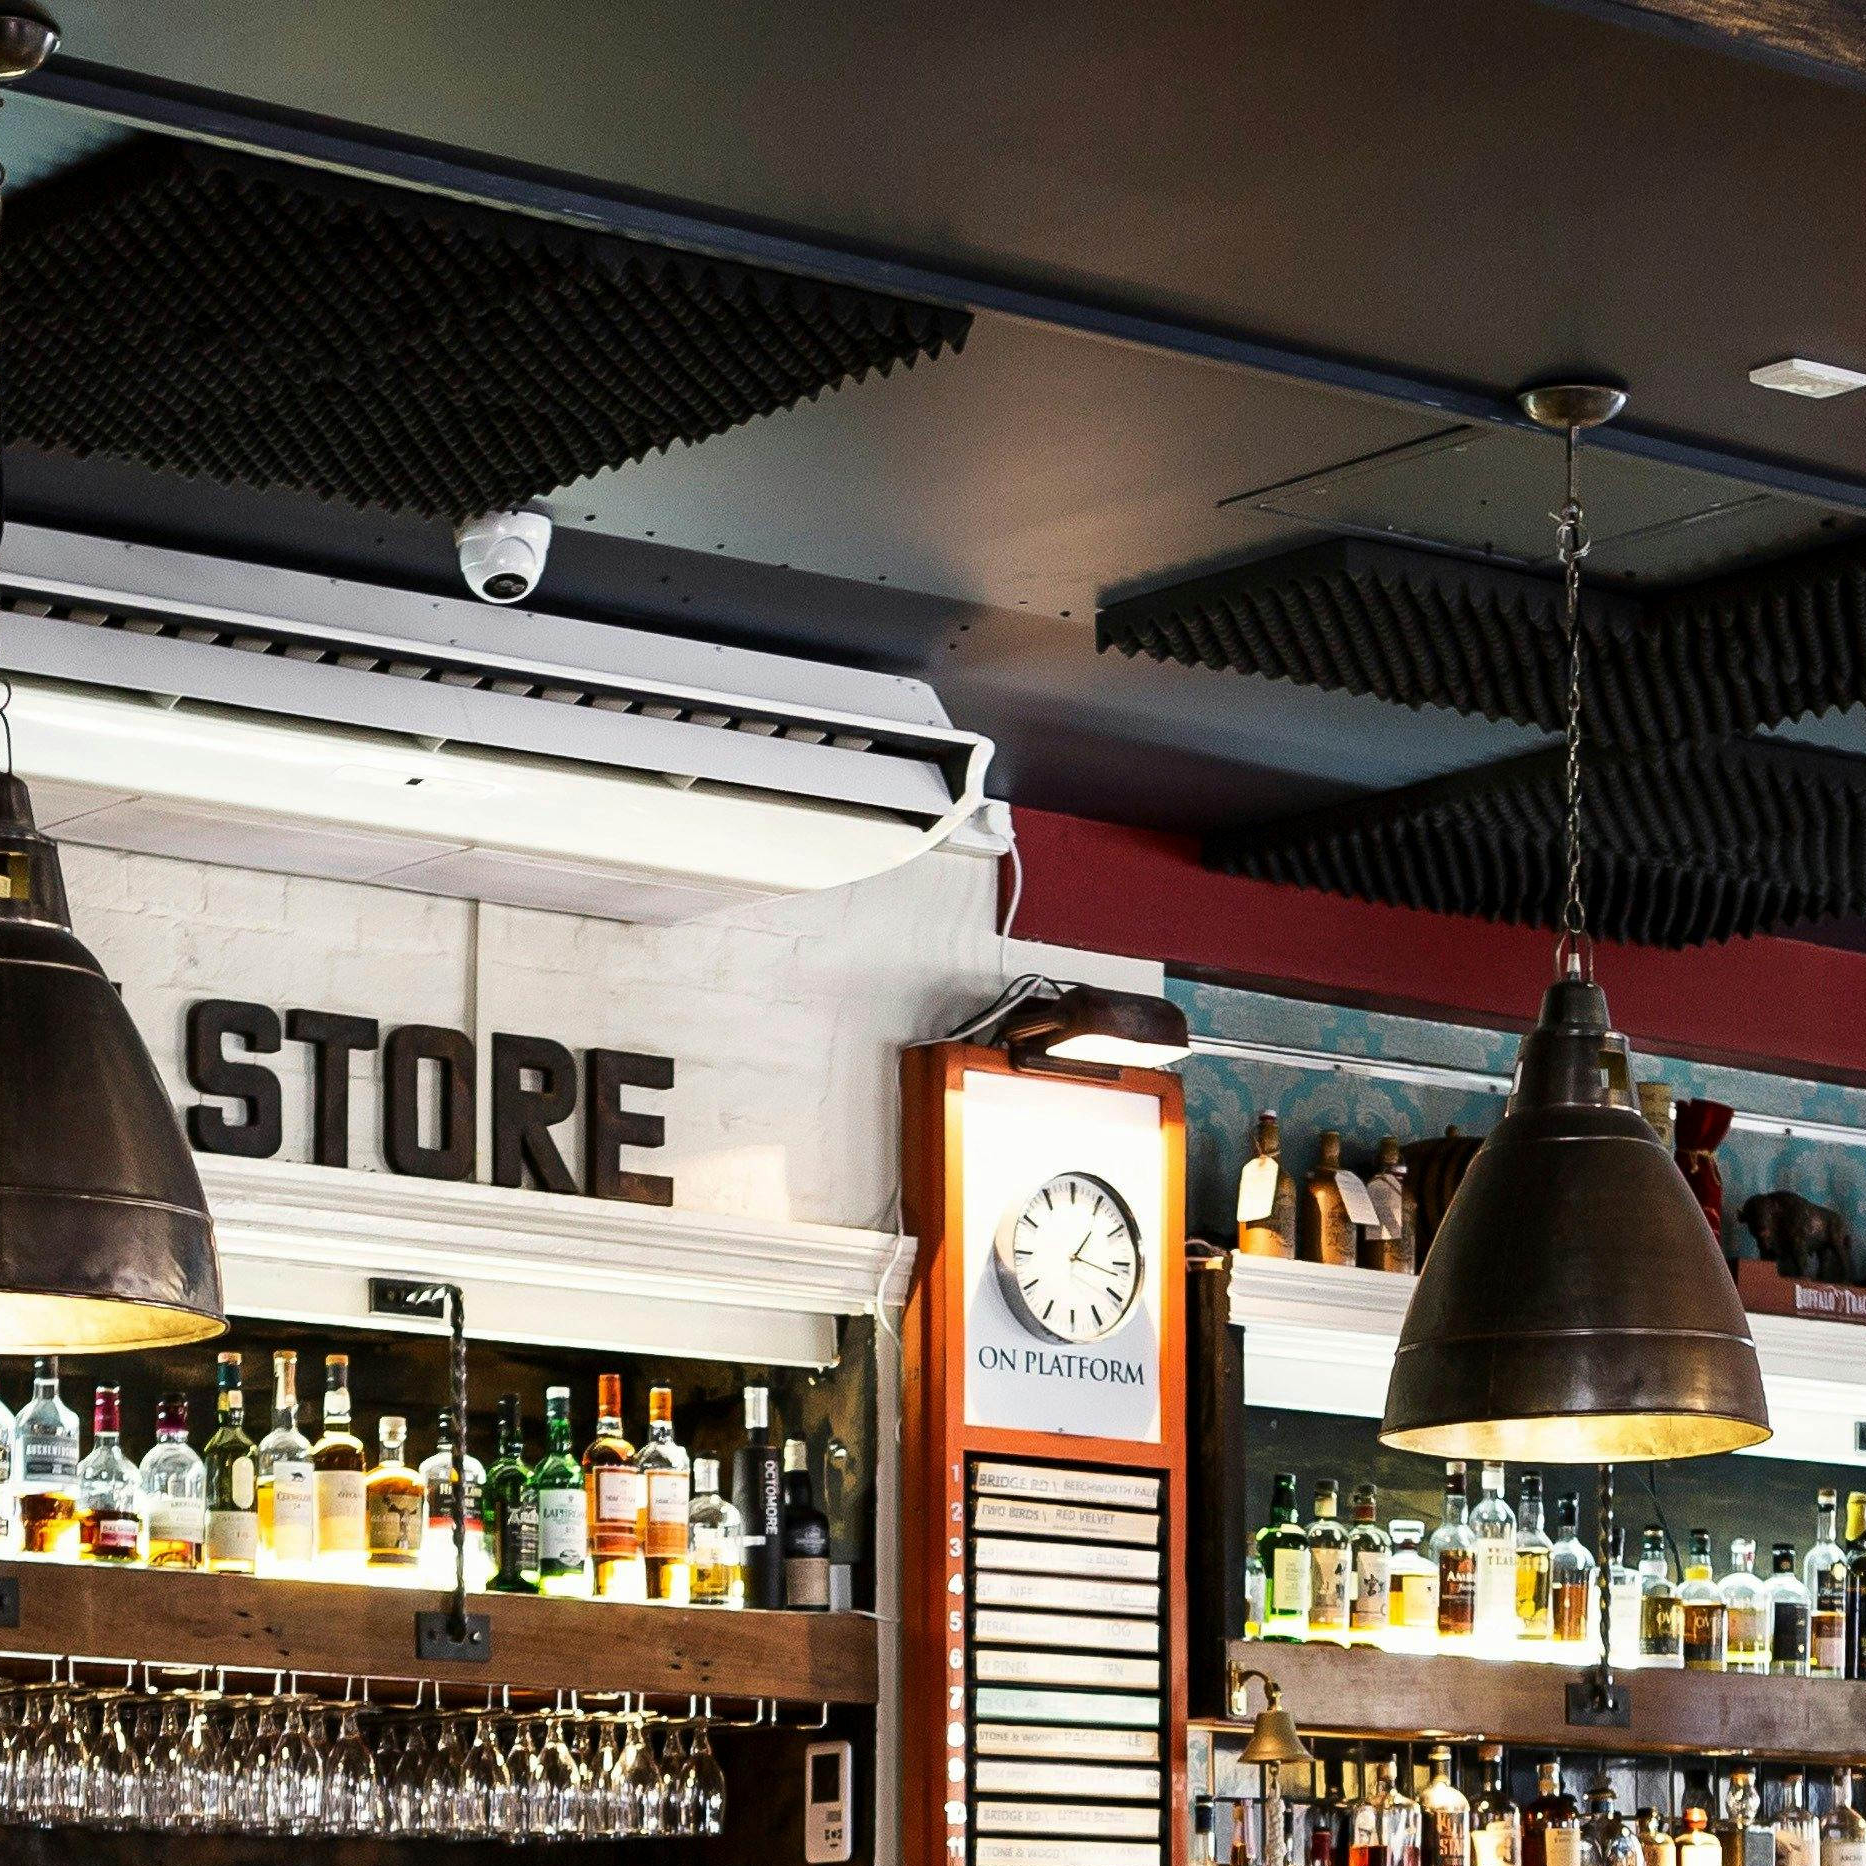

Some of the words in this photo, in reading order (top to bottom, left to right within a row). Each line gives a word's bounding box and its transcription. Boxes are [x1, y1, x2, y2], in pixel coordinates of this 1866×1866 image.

[186, 998, 675, 1207] STORE
[978, 1346, 1016, 1370] ON
[1024, 1350, 1145, 1385] PLATFORM
[951, 1464, 959, 1482] 1
[979, 1473, 1026, 1489] BRIDGE
[763, 1458, 779, 1536] OCTOMORE
[950, 1502, 963, 1522] 2
[981, 1503, 1005, 1516] TWO
[1009, 1506, 1040, 1521] BIRDS
[1055, 1508, 1077, 1521] RED
[1079, 1511, 1116, 1525] VELVET
[949, 1537, 963, 1558] 3
[947, 1573, 964, 1595] 4
[949, 1610, 963, 1633] 5
[949, 1647, 963, 1670] 6
[949, 1685, 964, 1710] 7
